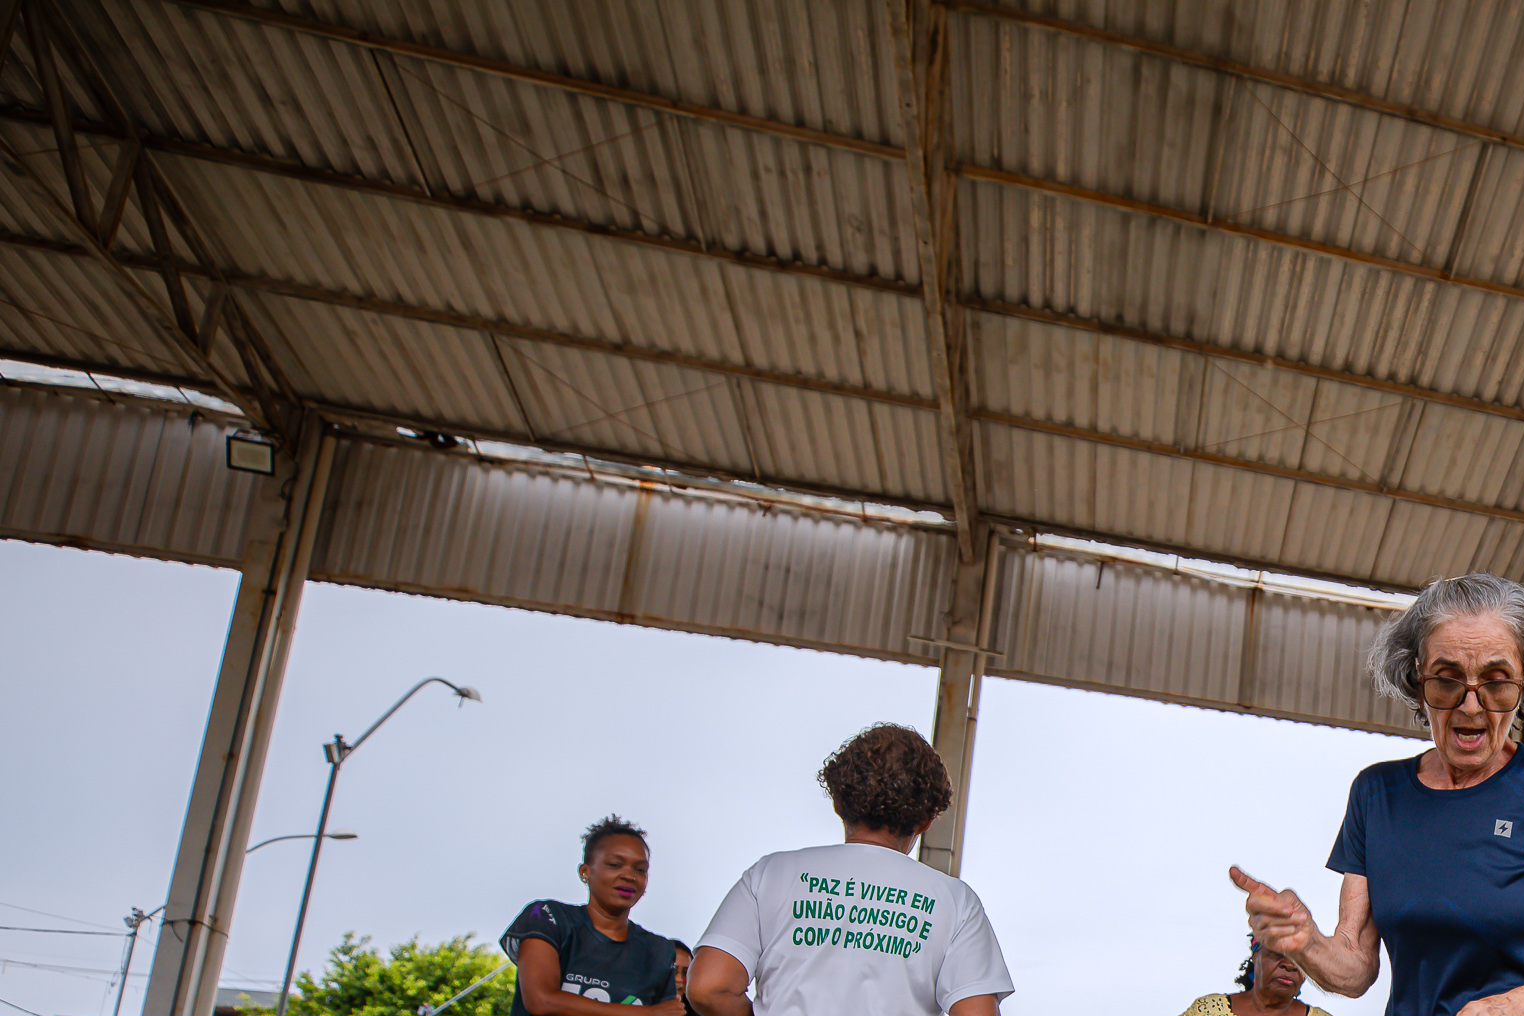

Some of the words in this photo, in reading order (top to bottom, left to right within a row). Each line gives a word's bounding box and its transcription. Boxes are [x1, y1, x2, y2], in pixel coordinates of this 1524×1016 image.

[845, 877, 856, 897] É
[861, 881, 908, 905] VIVER
[910, 892, 936, 915] EM
[792, 898, 845, 921] UNIÃO
[848, 905, 918, 934] CONSIGO
[918, 920, 933, 941] E
[792, 926, 830, 947] COM
[831, 927, 842, 946] O
[565, 973, 611, 989] GRUPO
